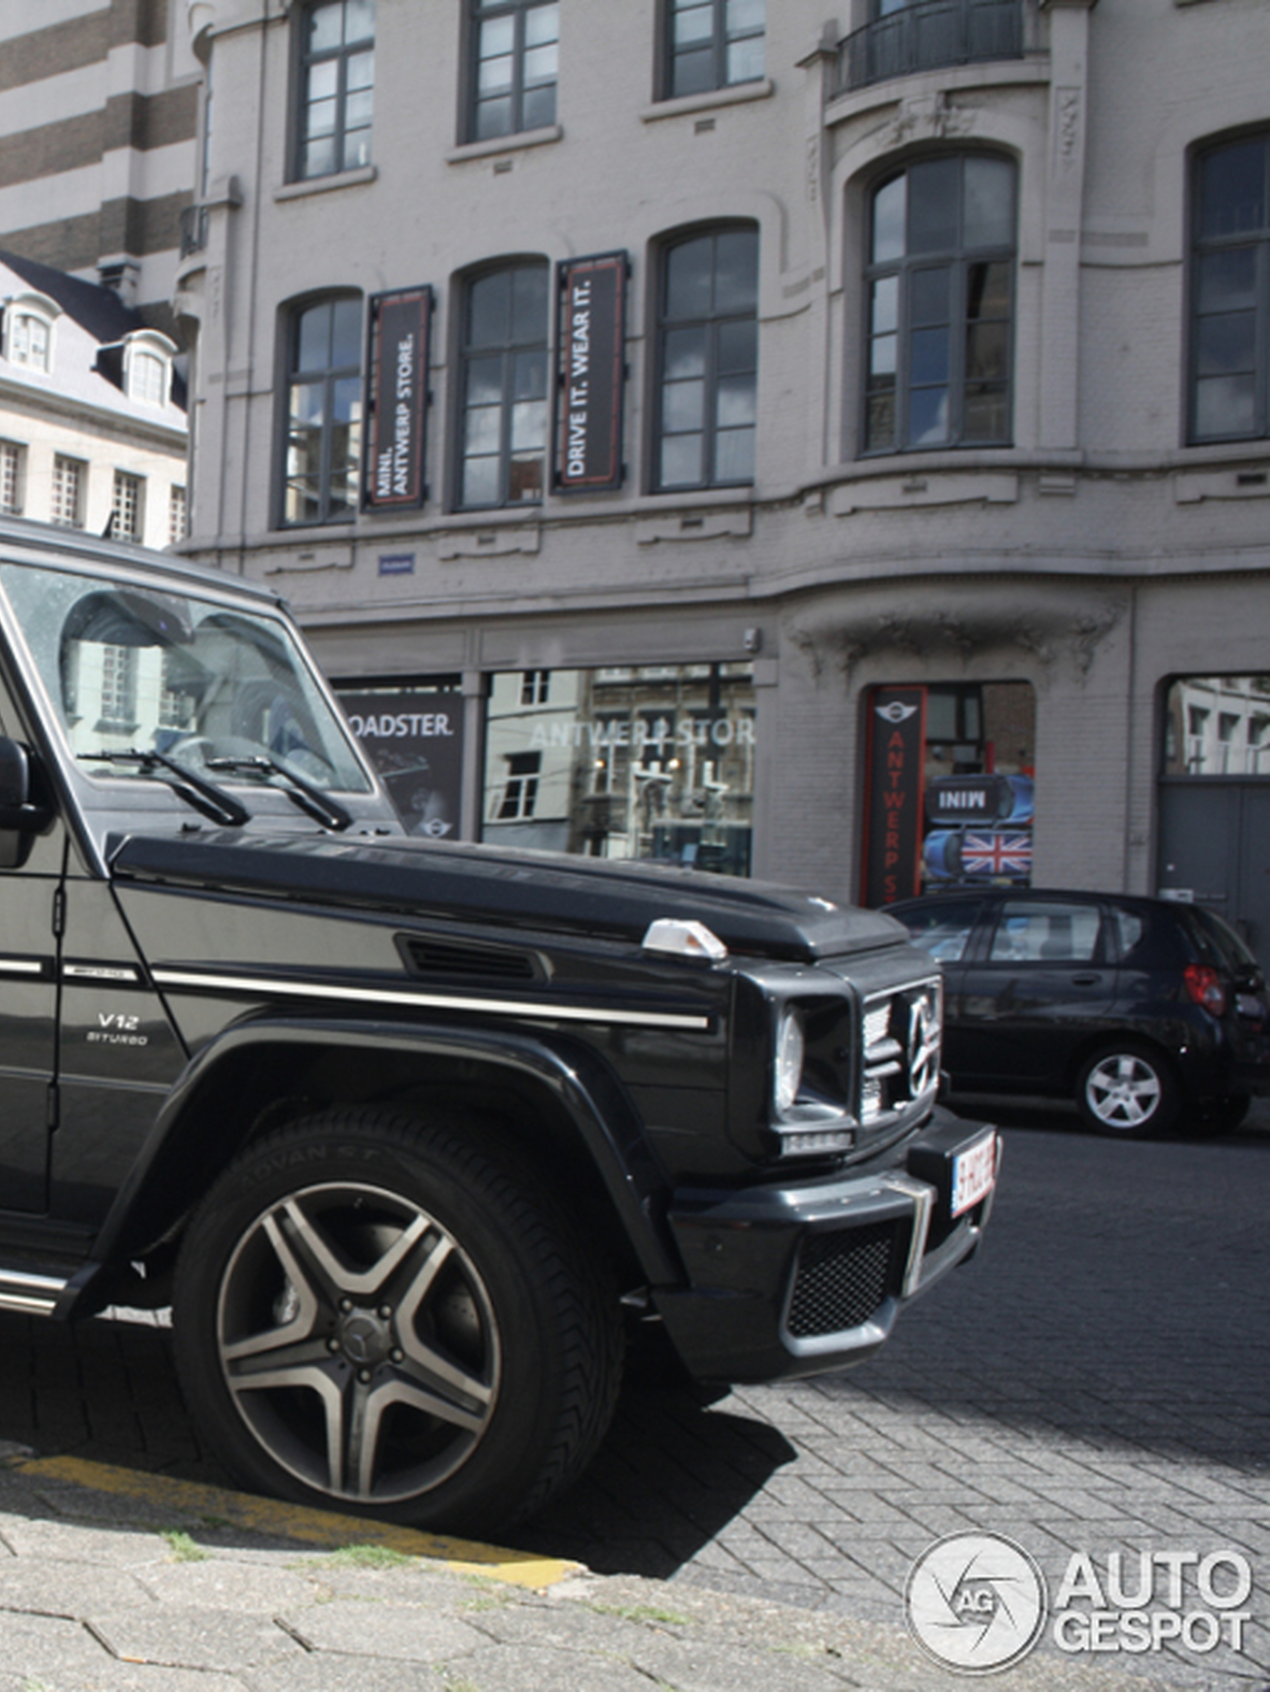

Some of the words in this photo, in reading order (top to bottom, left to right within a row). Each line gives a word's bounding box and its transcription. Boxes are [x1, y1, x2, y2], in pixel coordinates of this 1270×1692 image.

[574, 279, 591, 306] IT.
[571, 310, 590, 377] WEAR
[396, 333, 413, 400] STORE.
[571, 381, 588, 407] IT.
[393, 402, 410, 495] ANTWERP
[567, 411, 587, 477] DRIVE
[377, 447, 393, 496] MINI.
[349, 712, 454, 737] OADSTER.
[677, 715, 756, 746] STOR
[883, 731, 905, 869] ANTWERP
[86, 1031, 148, 1046] BITURBO
[98, 1012, 140, 1031] V12
